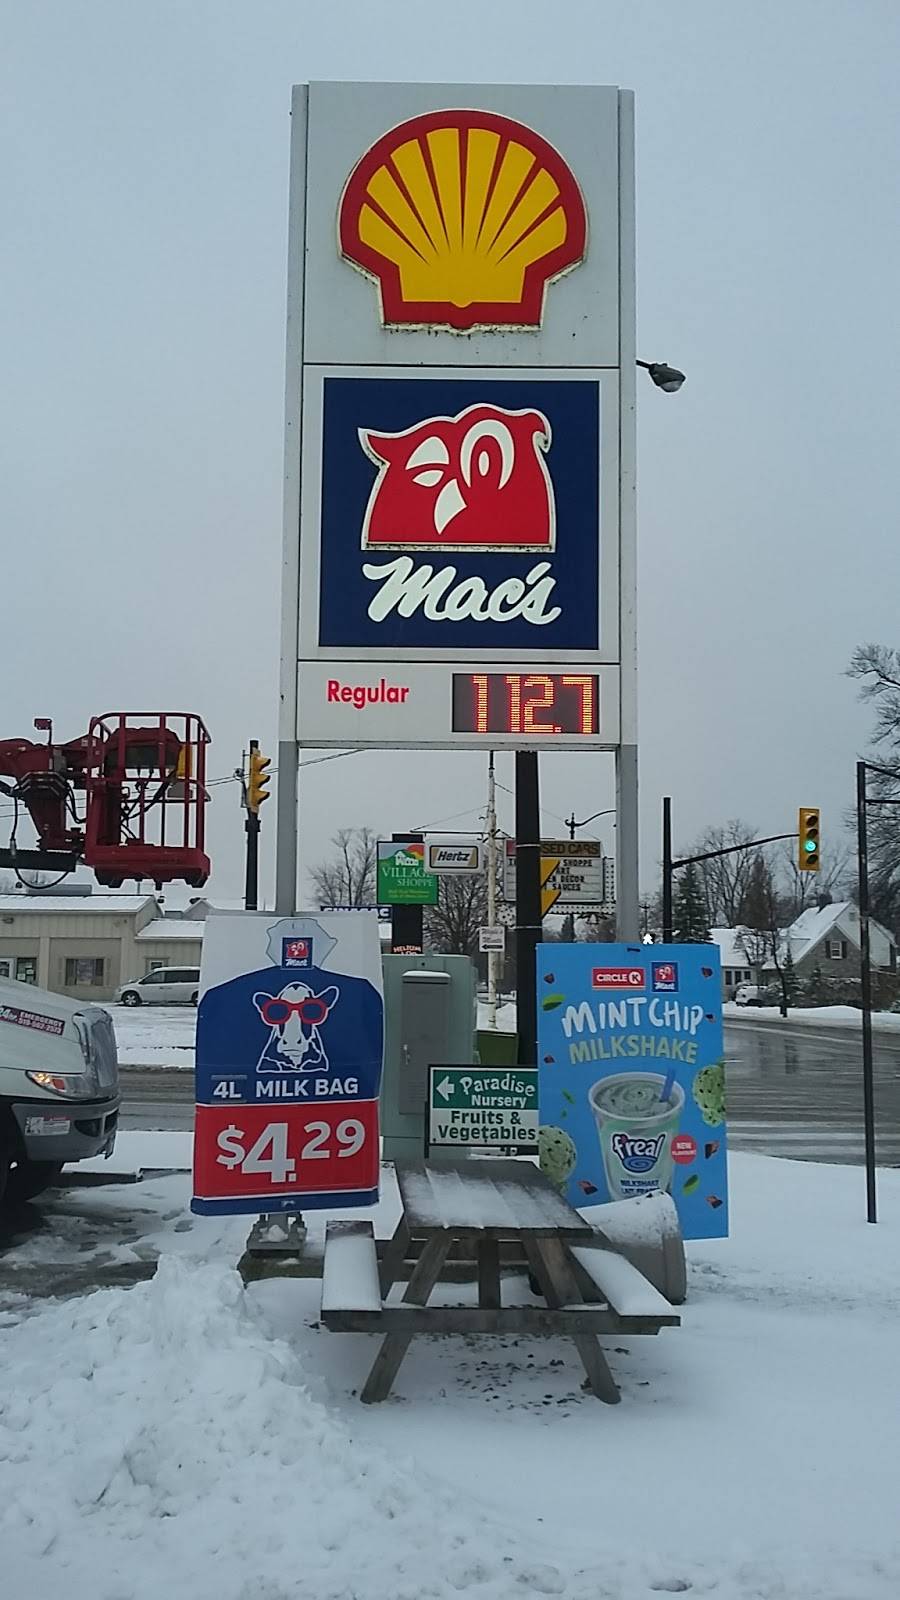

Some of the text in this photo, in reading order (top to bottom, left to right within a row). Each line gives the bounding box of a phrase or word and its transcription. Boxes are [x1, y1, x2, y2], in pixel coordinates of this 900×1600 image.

[362, 555, 562, 625] Mac's
[327, 678, 410, 709] Regular
[437, 850, 471, 862] Hertz
[542, 843, 599, 854] SED CARS
[563, 859, 593, 867] SHOPPE
[397, 878, 433, 887] SHOPPE
[596, 971, 641, 984] CIRCLE K
[561, 996, 704, 1038] MINT CHIP
[569, 1034, 699, 1065] MILKSHAKE
[213, 1077, 359, 1099] 4L MILK BAG
[459, 1073, 536, 1097] Paradise
[472, 1095, 527, 1108] Nursery
[451, 1110, 521, 1124] Fruits &
[438, 1125, 537, 1141] Vegetables
[216, 1119, 366, 1184] $4.29
